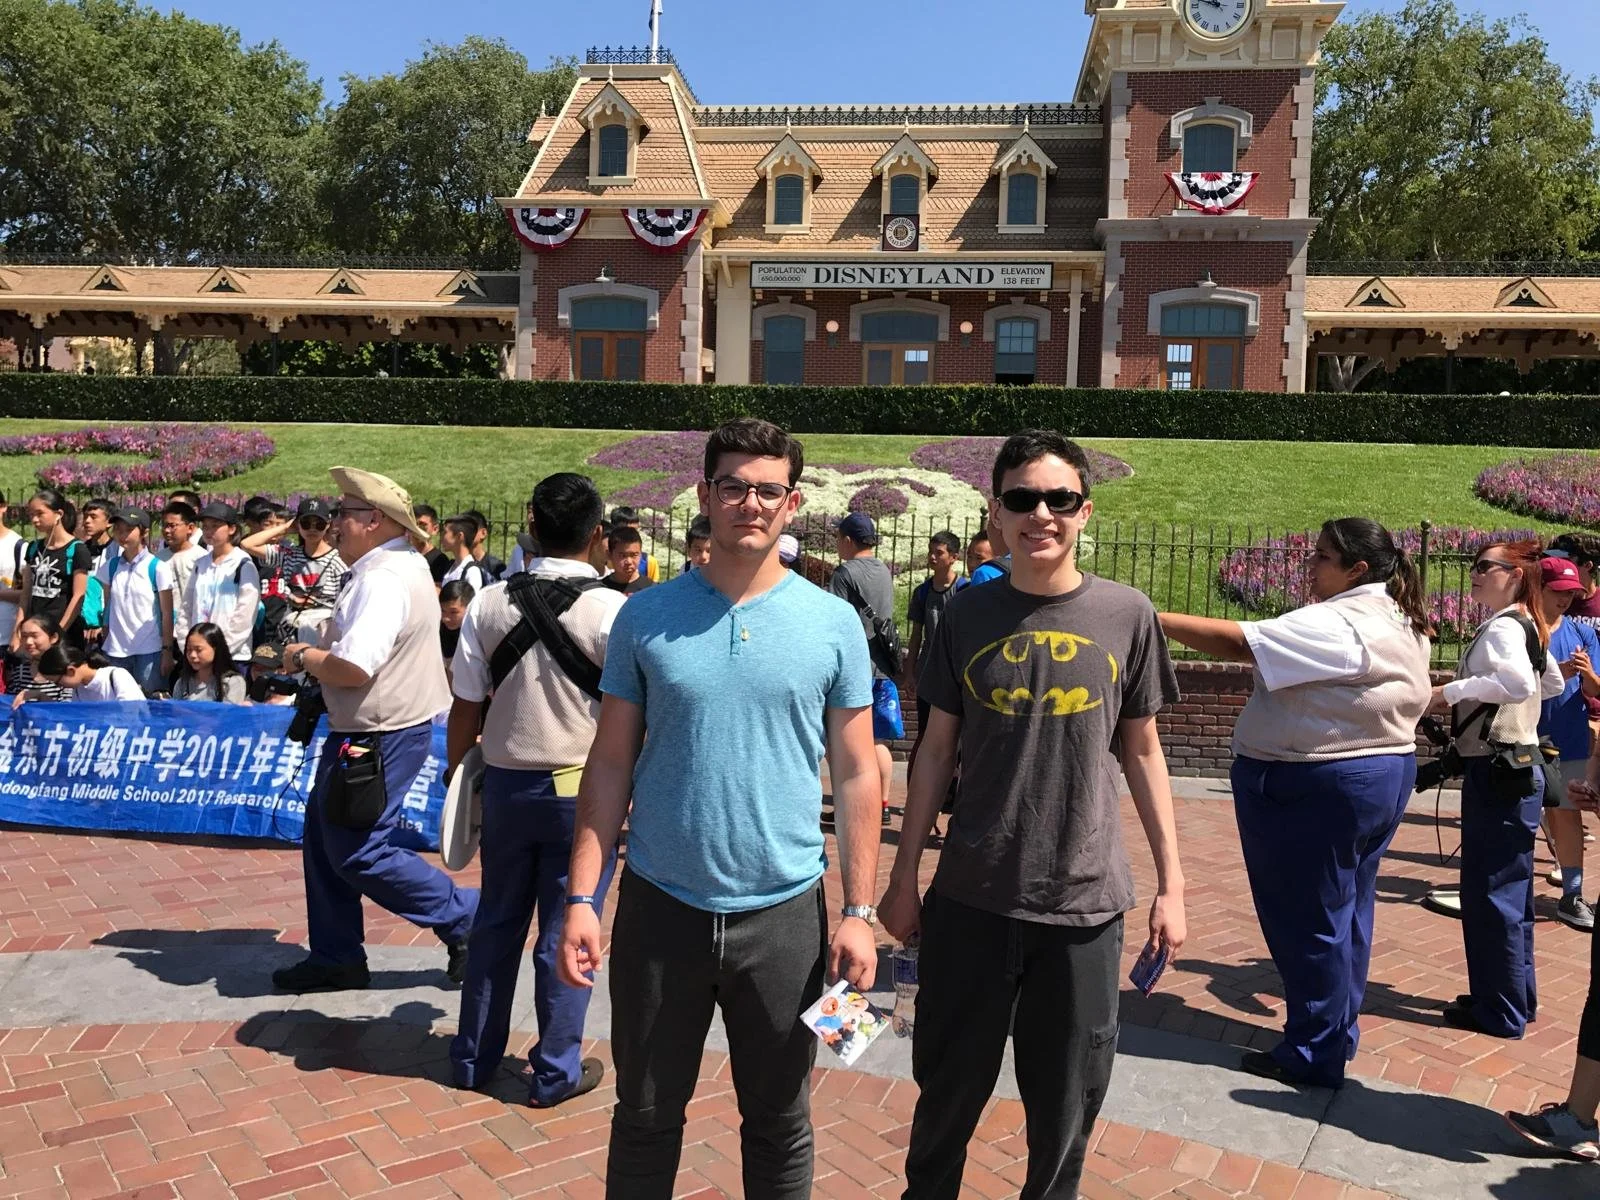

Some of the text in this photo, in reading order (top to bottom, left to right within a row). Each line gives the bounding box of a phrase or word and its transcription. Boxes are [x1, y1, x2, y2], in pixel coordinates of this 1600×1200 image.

[758, 266, 807, 274] POPULATION
[1001, 267, 1045, 276] ELEVATION
[814, 267, 994, 285] DISNEYLAND
[1003, 277, 1041, 285] 138 FEET
[71, 783, 119, 801] Middle
[122, 785, 176, 804] School
[176, 788, 214, 807] 2017
[214, 789, 283, 810] Research
[401, 814, 424, 834] ica
